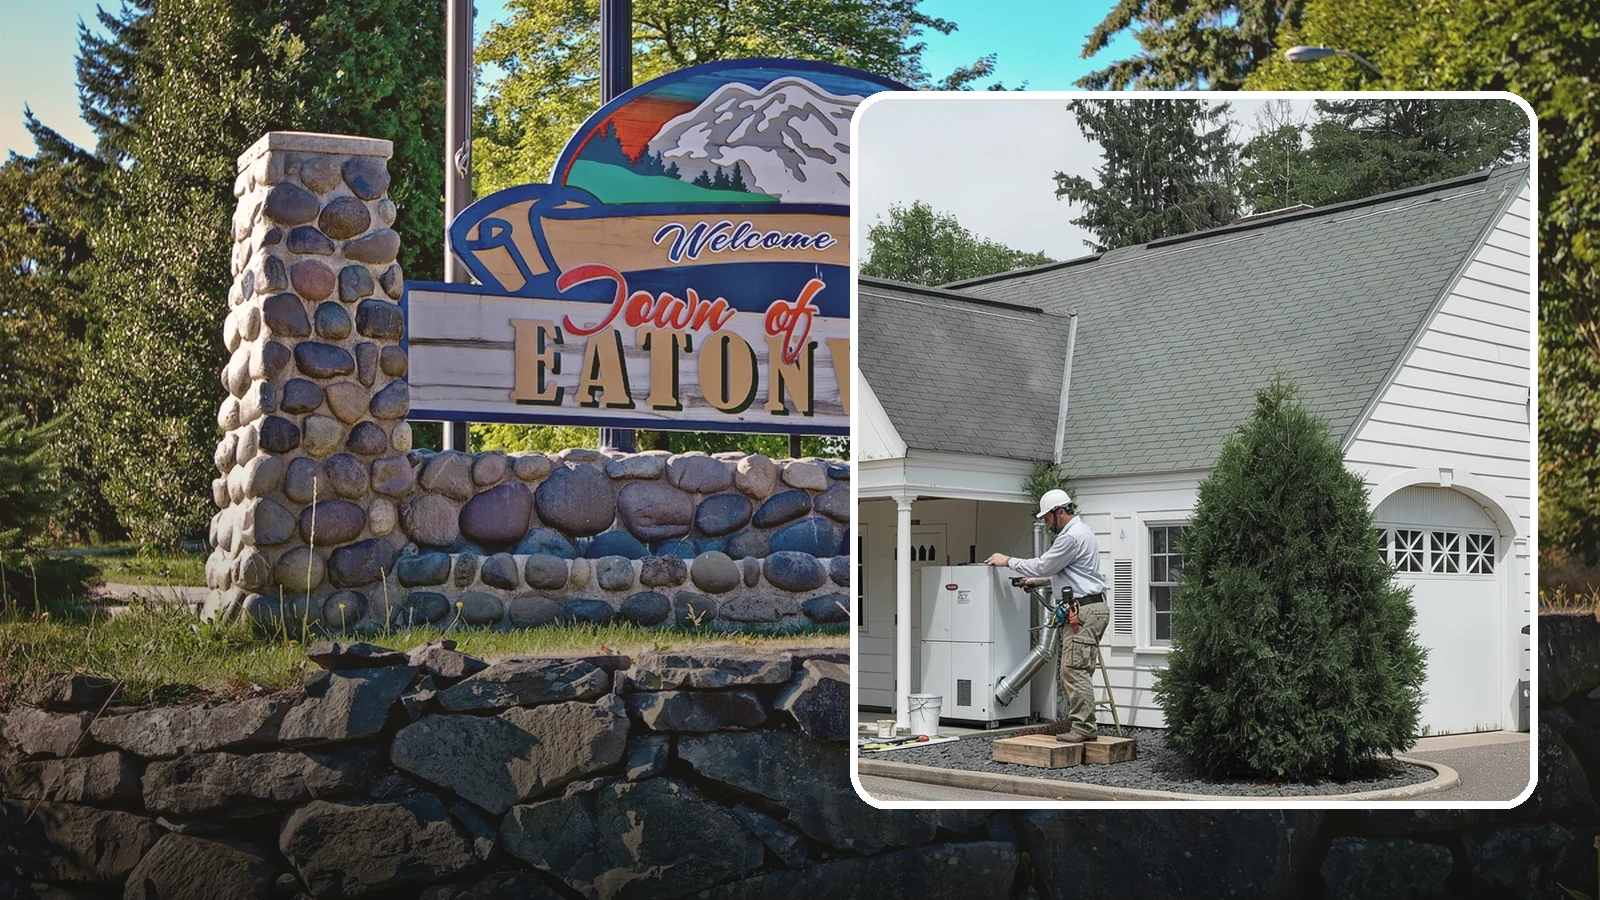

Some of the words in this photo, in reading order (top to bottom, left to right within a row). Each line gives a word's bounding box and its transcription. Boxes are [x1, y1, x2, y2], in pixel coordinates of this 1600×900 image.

[653, 220, 837, 263] Welcome
[556, 263, 737, 336] Town
[764, 278, 825, 365] of
